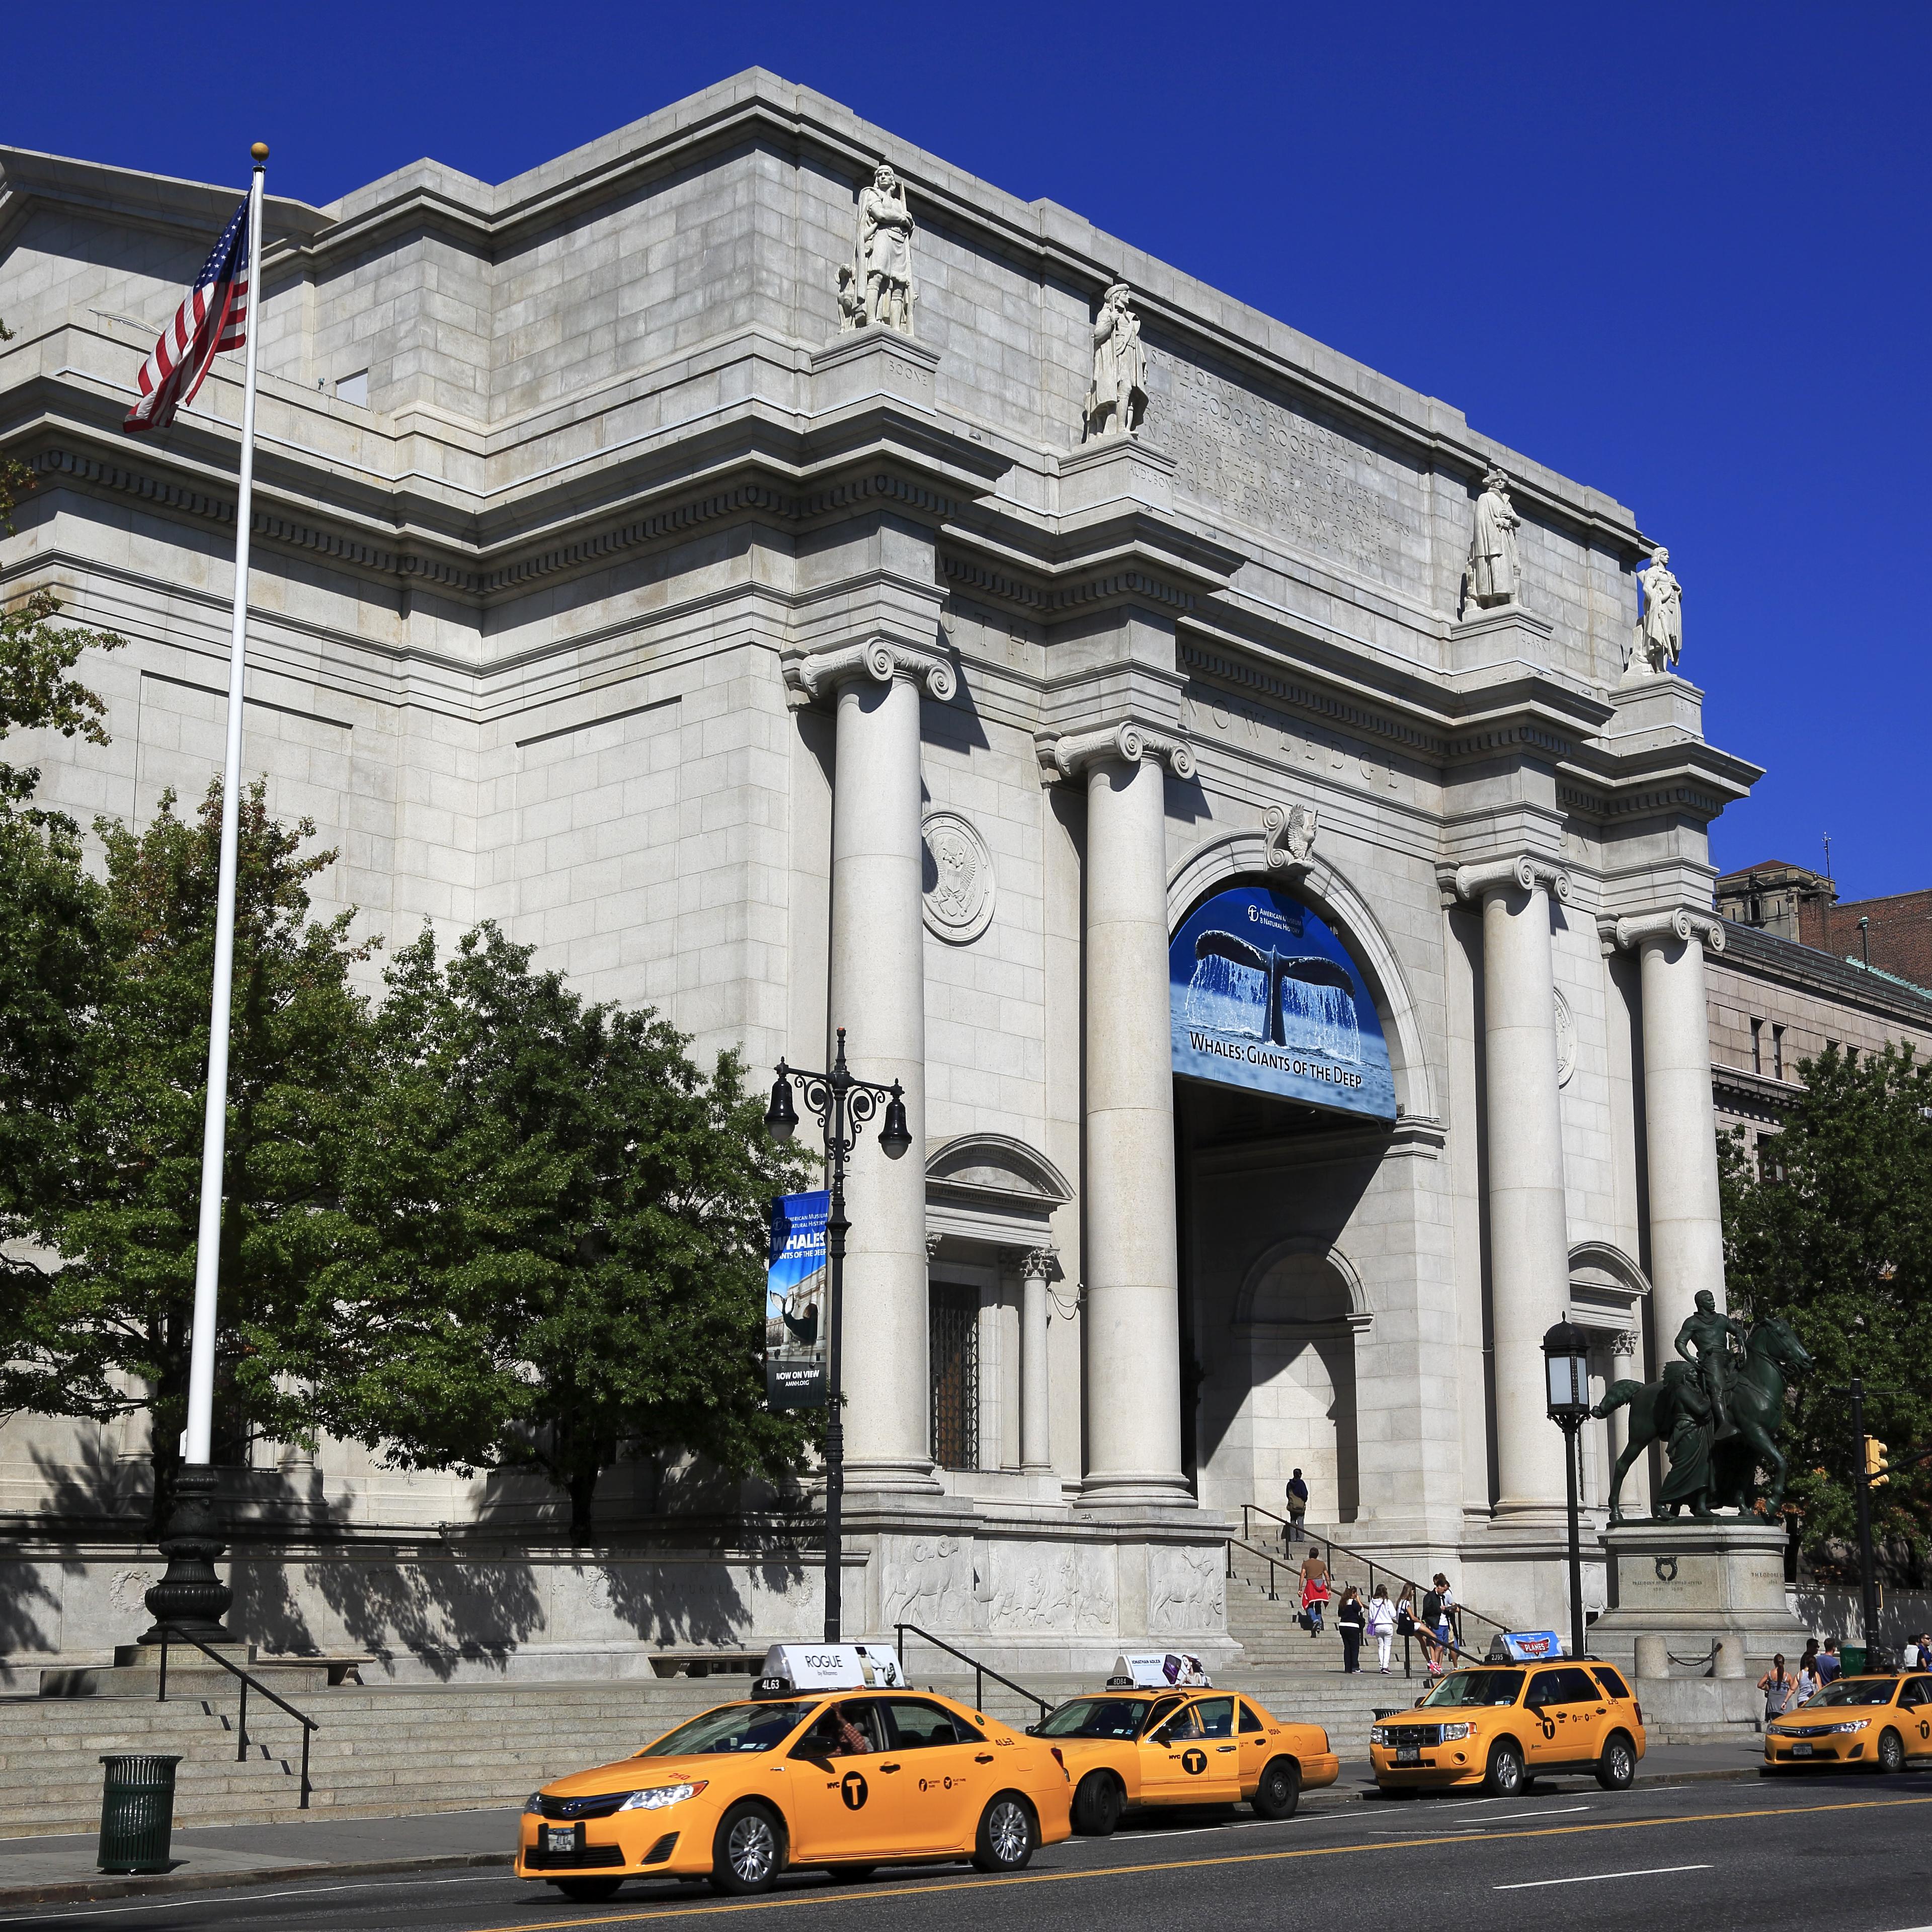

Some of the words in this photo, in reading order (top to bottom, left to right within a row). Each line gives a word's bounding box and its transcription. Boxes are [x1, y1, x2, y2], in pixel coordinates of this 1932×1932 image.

[889, 360, 927, 386] BOONE
[1151, 349, 1189, 380] STATE
[1195, 371, 1212, 389] OF
[1218, 380, 1246, 404] NEW
[1251, 396, 1289, 427] YORK
[1290, 415, 1353, 457] MEMORIAL
[1357, 447, 1373, 466] TO
[1179, 382, 1262, 436] THEODORE
[1268, 424, 1348, 475] ROOSEVELT
[1148, 391, 1186, 418] GREAT
[1192, 411, 1235, 441] LEADER
[1239, 433, 1252, 449] OF
[1258, 441, 1278, 460] THE
[1284, 453, 1320, 479] YOUTH
[1342, 479, 1388, 511] AMERICA
[1163, 432, 1210, 464] DEFENSE
[1130, 464, 1171, 490] AUDUBON
[1180, 457, 1209, 480] LOVE
[1216, 472, 1237, 492] AND
[1243, 486, 1326, 531] CONSERVATION
[1521, 633, 1546, 652] CLARK
[1181, 688, 1398, 789] NOWLEDGE
[1259, 908, 1282, 921] AMERICAN
[1282, 915, 1301, 926] MUSEUM
[1263, 917, 1282, 930] NATURAL
[1282, 924, 1300, 934] HISTORY
[1190, 1030, 1245, 1061] WHALES:
[1247, 1045, 1290, 1072] GIANTS
[1293, 1060, 1307, 1076] OF
[1310, 1064, 1331, 1082] THE
[1334, 1066, 1361, 1088] DEEP
[773, 1231, 826, 1251] WHALES
[776, 1372, 791, 1380] NOW
[792, 1371, 802, 1379] ON
[803, 1370, 820, 1378] VIEW
[1524, 1643, 1546, 1651] PLANES
[805, 1655, 843, 1668] ROGUE
[762, 1679, 779, 1689] 4L63
[1545, 1721, 1552, 1736] T
[1922, 1724, 1927, 1737] T
[995, 1738, 1014, 1746] 4L63
[1187, 1753, 1201, 1771] T
[846, 1779, 861, 1805] T
